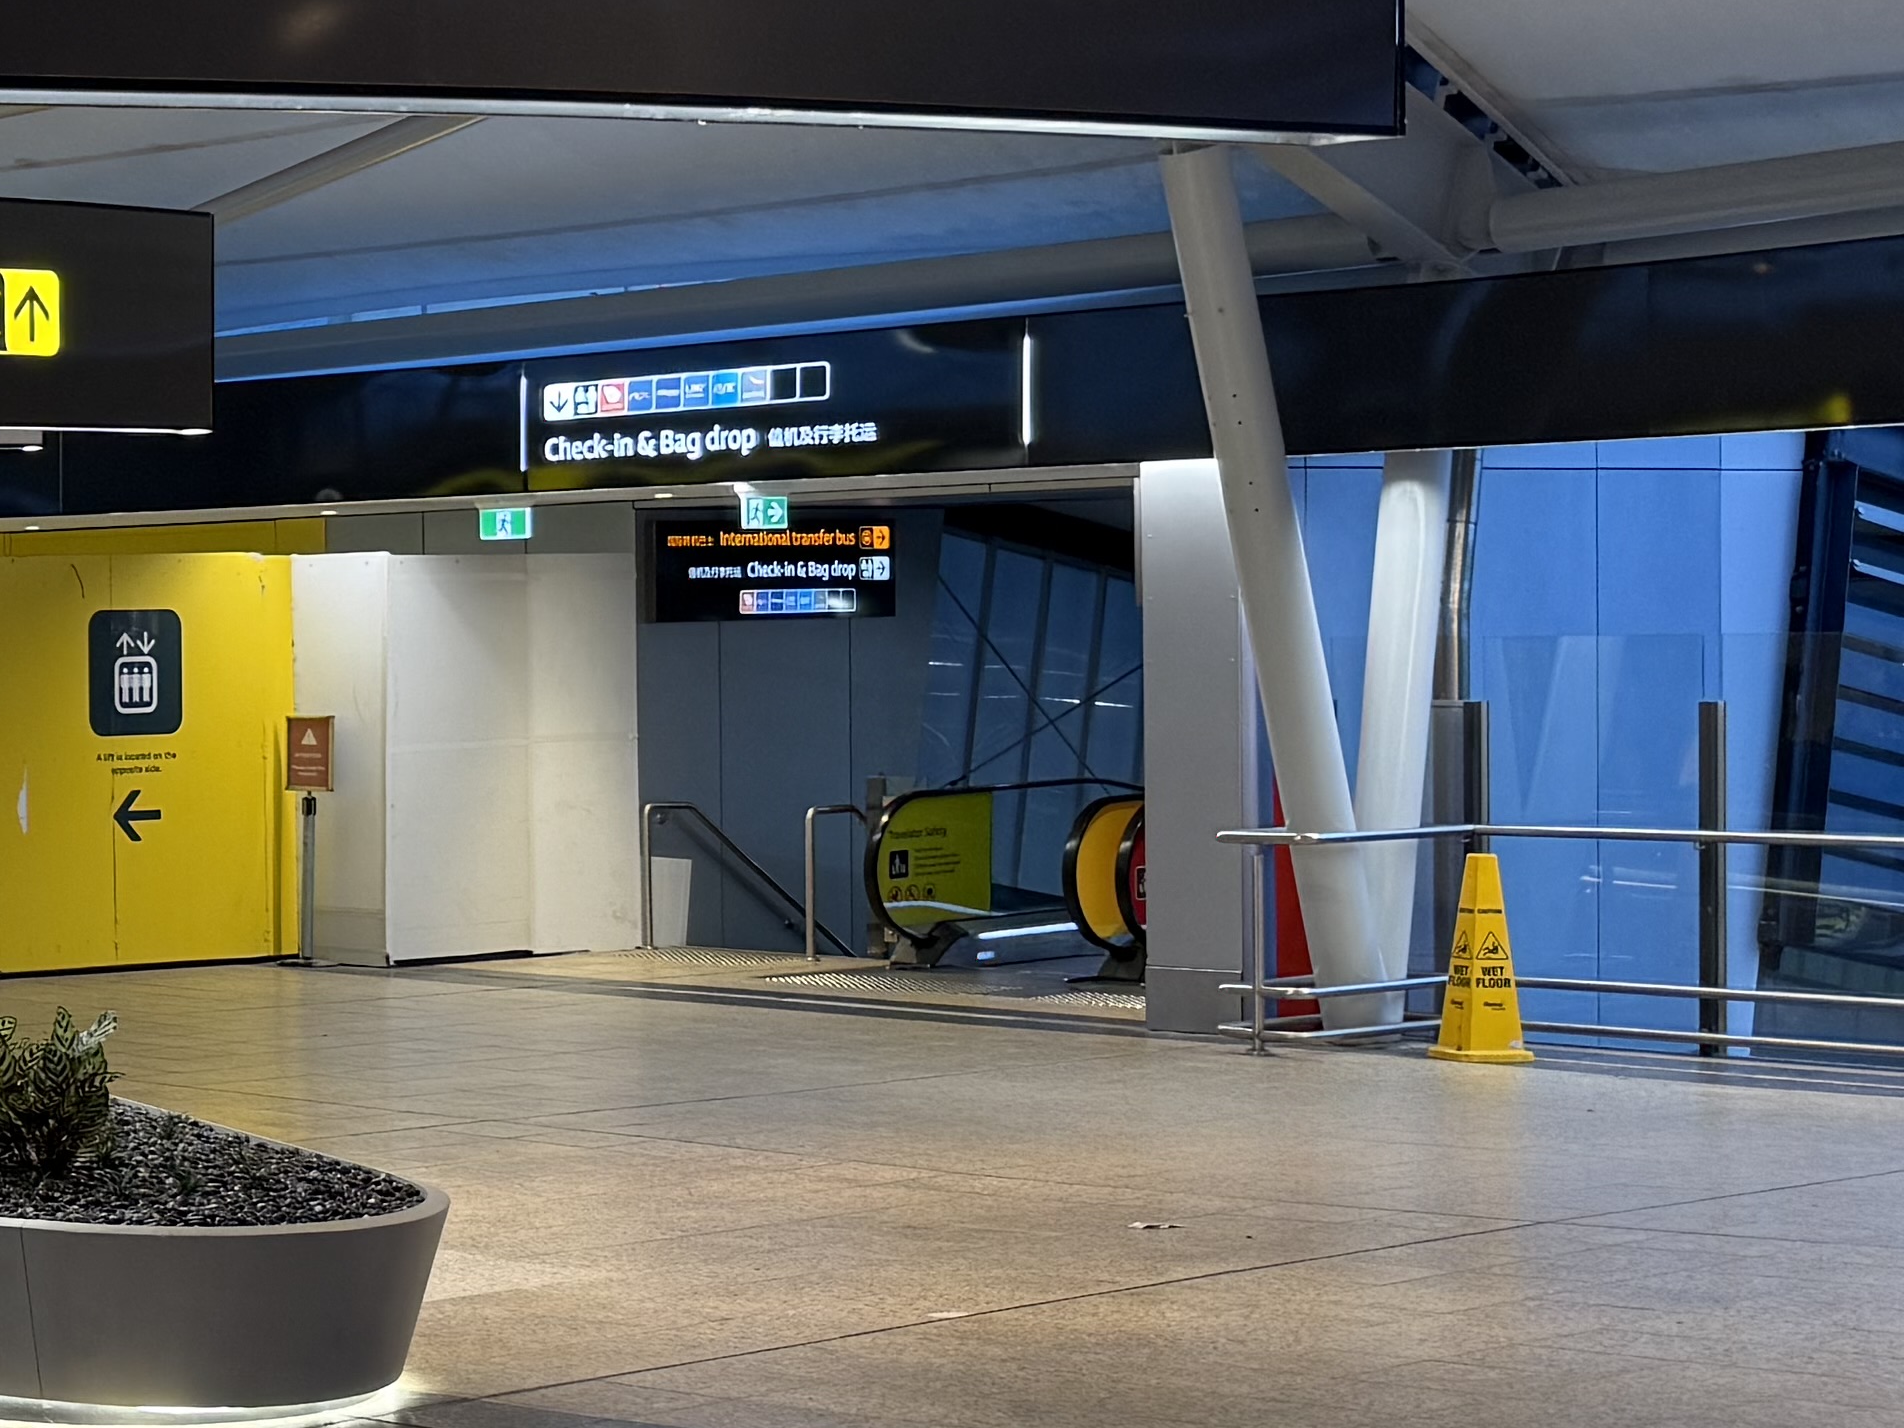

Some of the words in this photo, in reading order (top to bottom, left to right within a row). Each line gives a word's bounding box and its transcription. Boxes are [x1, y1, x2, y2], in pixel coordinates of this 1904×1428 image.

[544, 432, 634, 462] Check-in
[636, 431, 658, 457] &
[660, 429, 703, 460] Bag
[705, 424, 758, 456] drop
[719, 530, 791, 547] International
[792, 529, 835, 546] transfer
[835, 529, 856, 546] bus
[746, 560, 796, 578] Check-in
[808, 561, 830, 581] Bag
[830, 559, 857, 580] drop
[1480, 966, 1505, 977] WET
[1475, 977, 1512, 989] FLOOR
